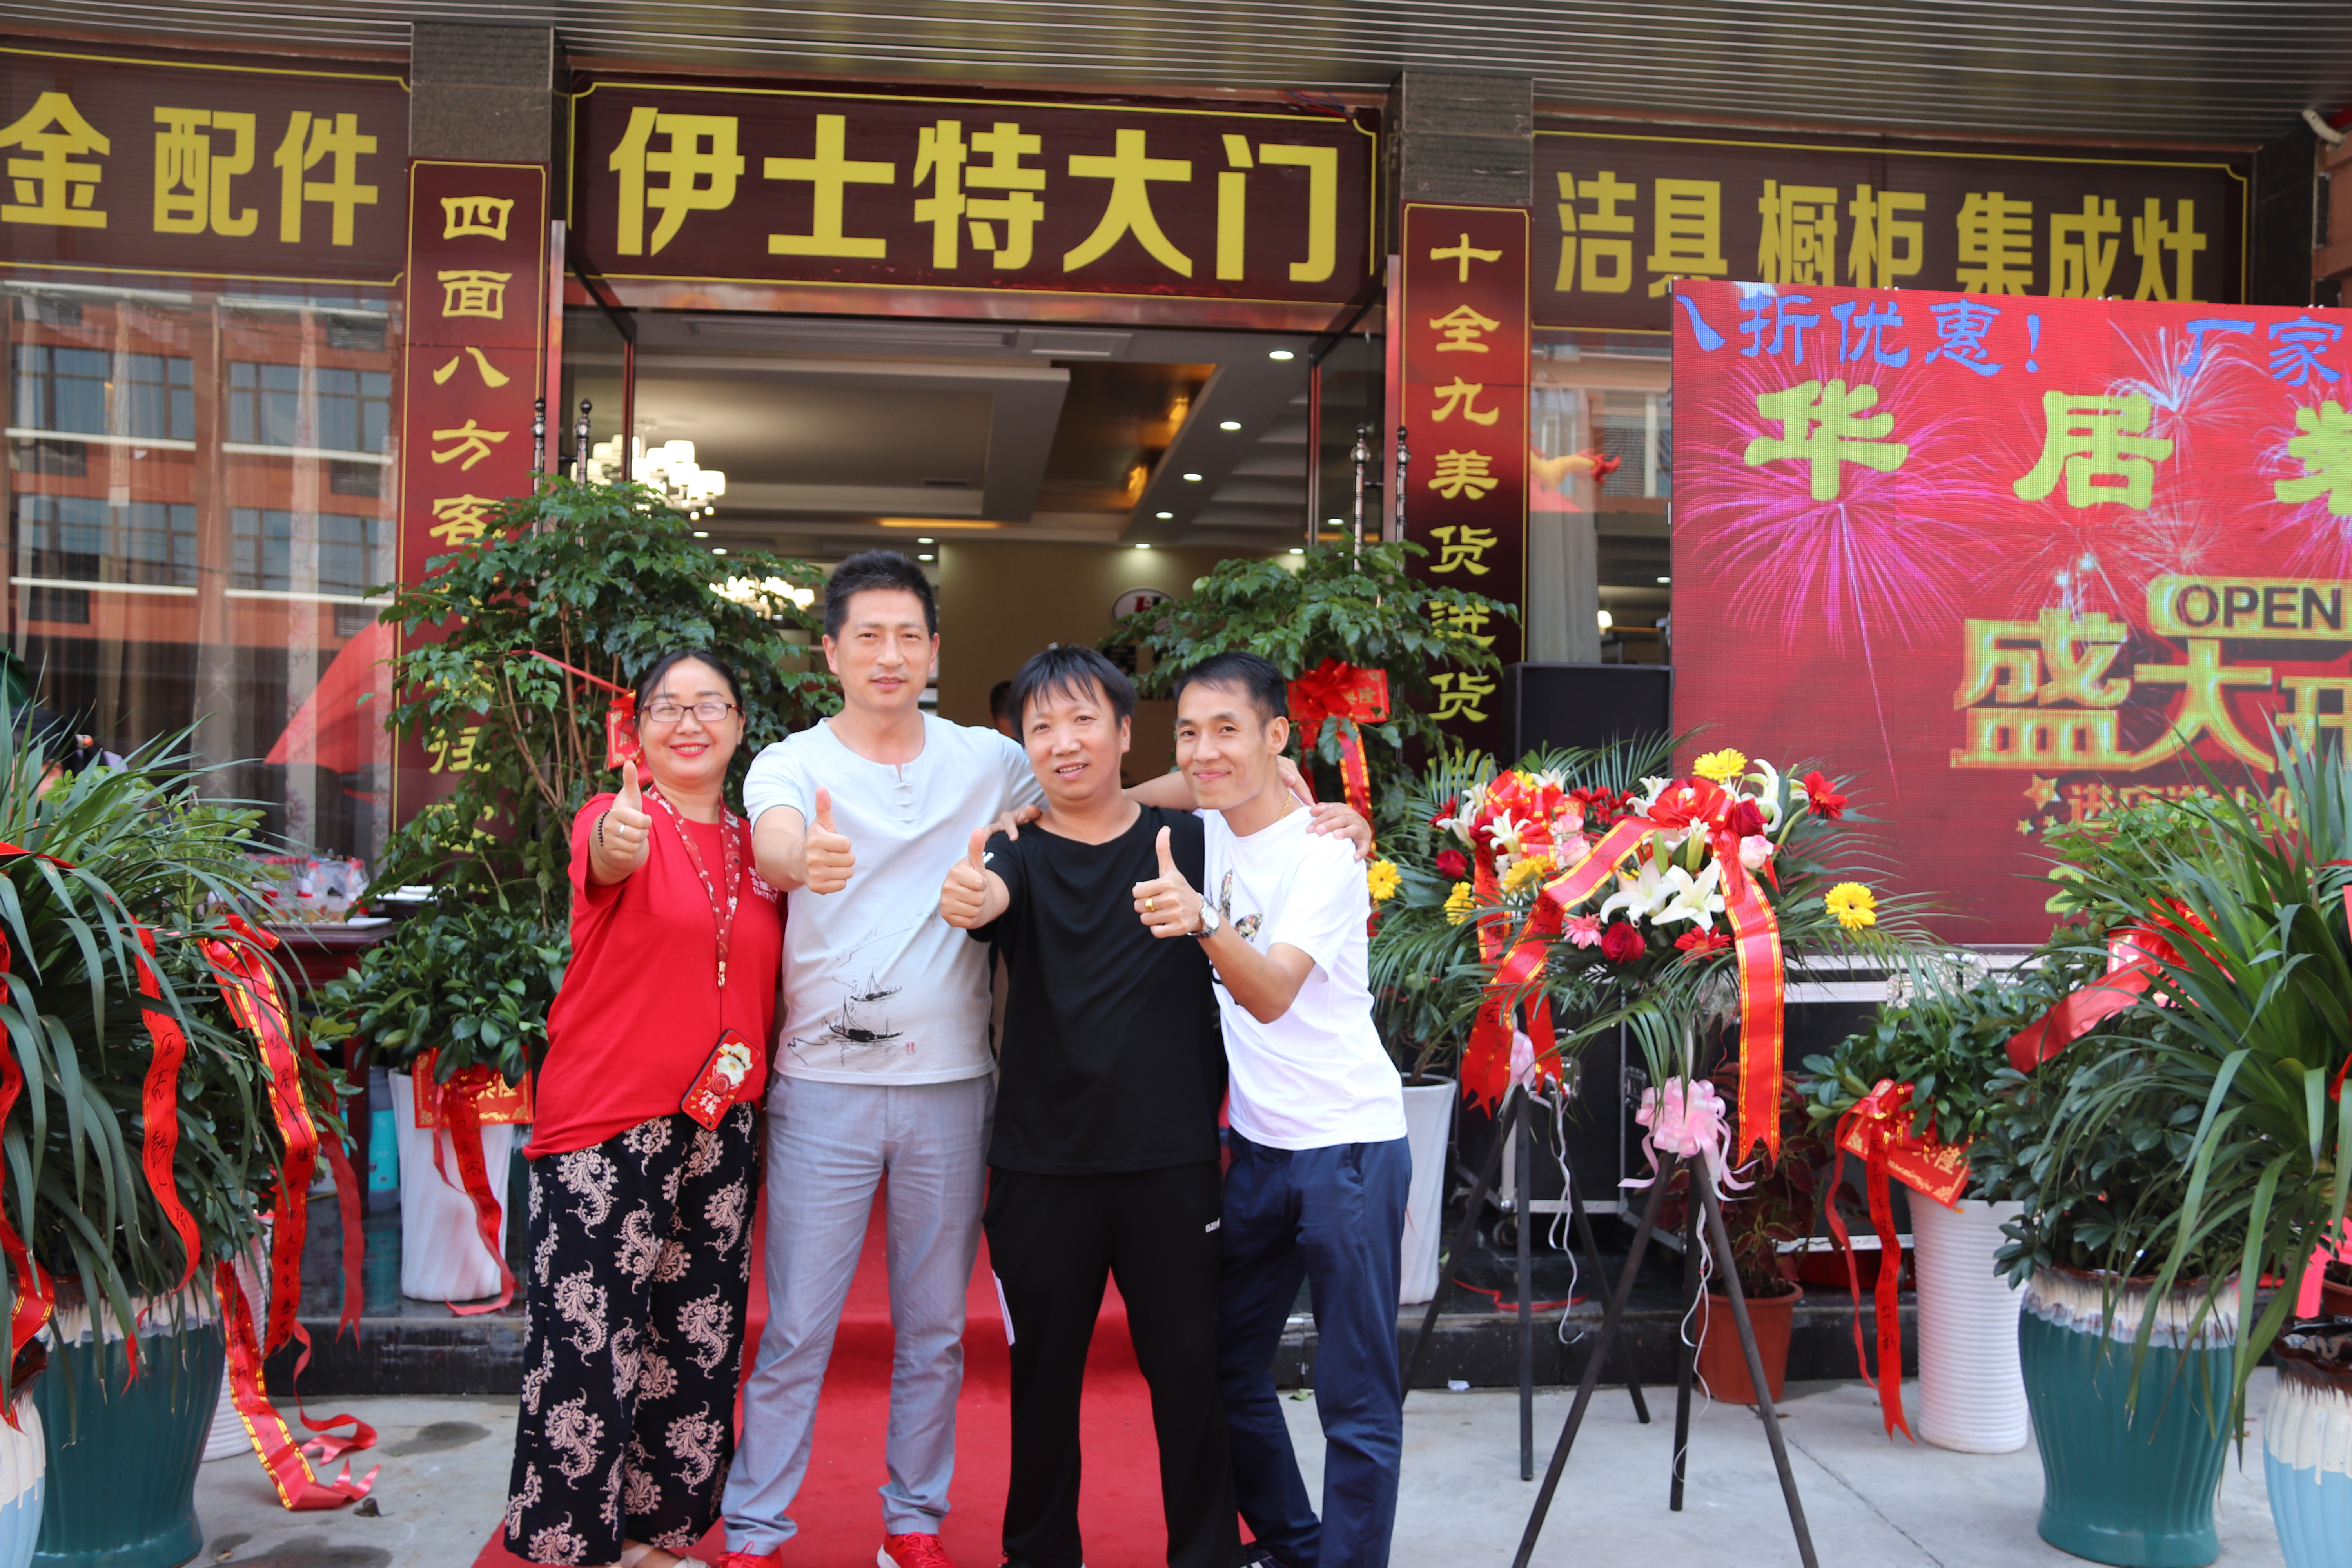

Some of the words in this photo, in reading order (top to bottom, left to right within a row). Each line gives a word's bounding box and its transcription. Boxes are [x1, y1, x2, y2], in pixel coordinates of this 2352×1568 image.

[608, 106, 1338, 283] 伊士特大门
[2176, 584, 2342, 629] OPEN
